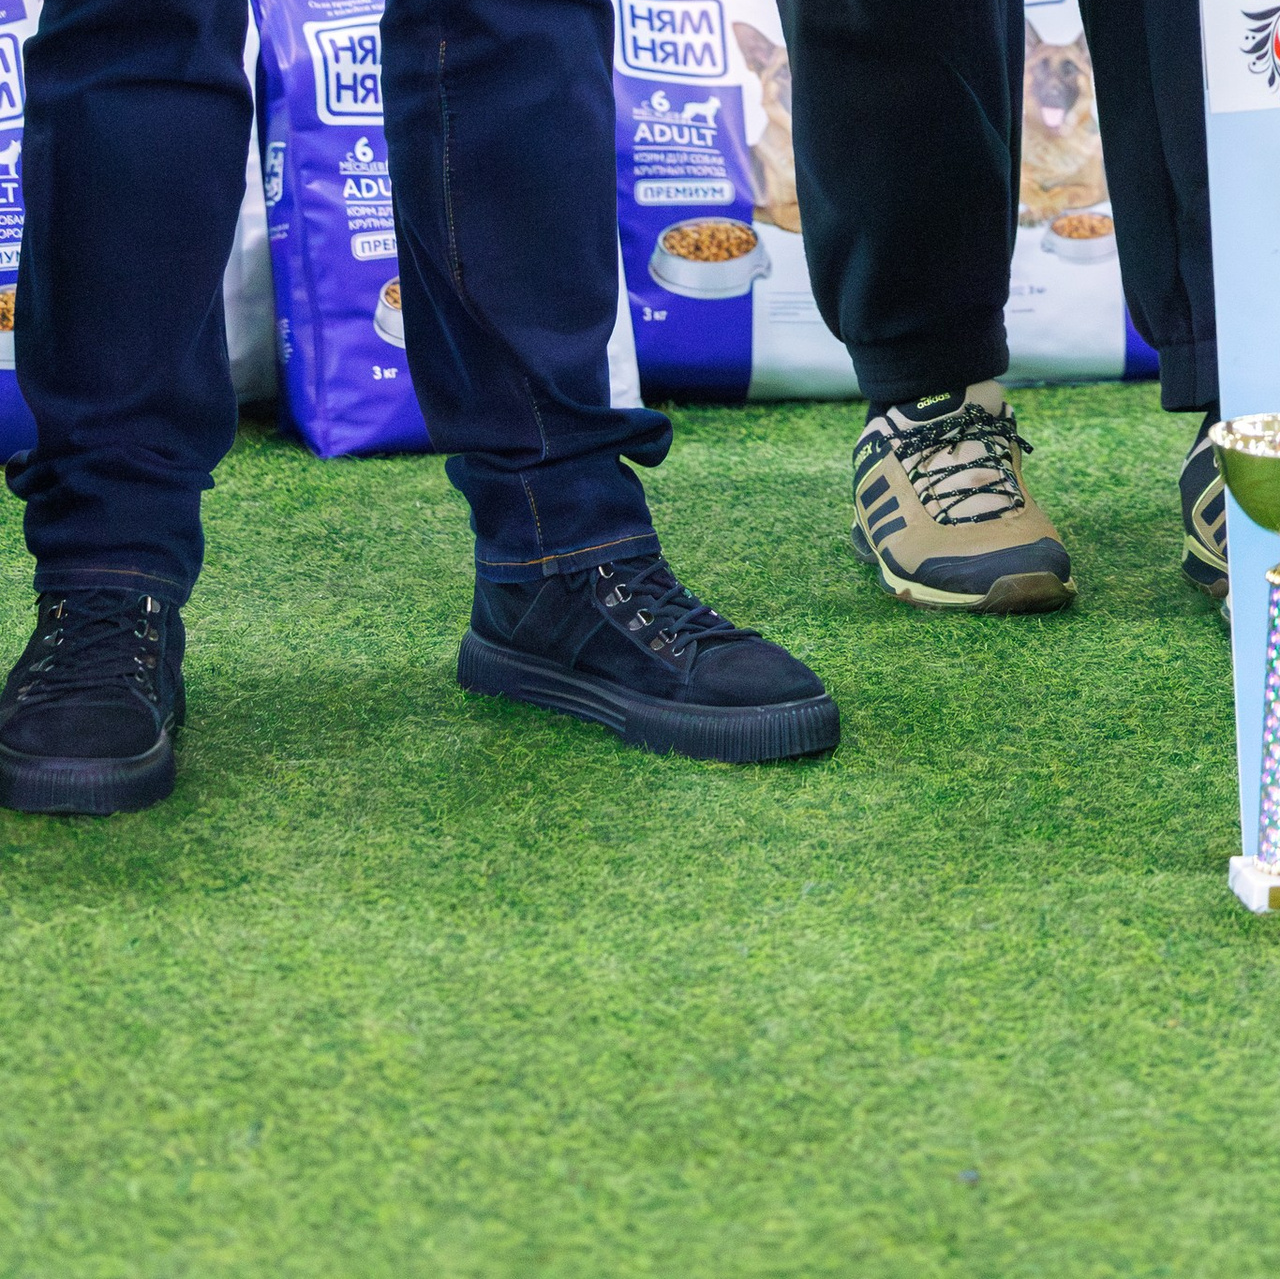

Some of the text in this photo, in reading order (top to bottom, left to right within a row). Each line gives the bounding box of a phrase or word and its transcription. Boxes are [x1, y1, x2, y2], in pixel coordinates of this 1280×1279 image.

[630, 4, 714, 34] НЯМ
[329, 35, 380, 65] НЯ
[632, 35, 717, 67] НЯМ
[336, 72, 380, 104] НЯ
[650, 90, 670, 112] 6
[634, 122, 718, 147] ADULT
[354, 136, 374, 163] 6
[343, 177, 392, 198] ADU
[643, 186, 725, 199] ПРЕМИУМ
[917, 392, 951, 409] adidas
